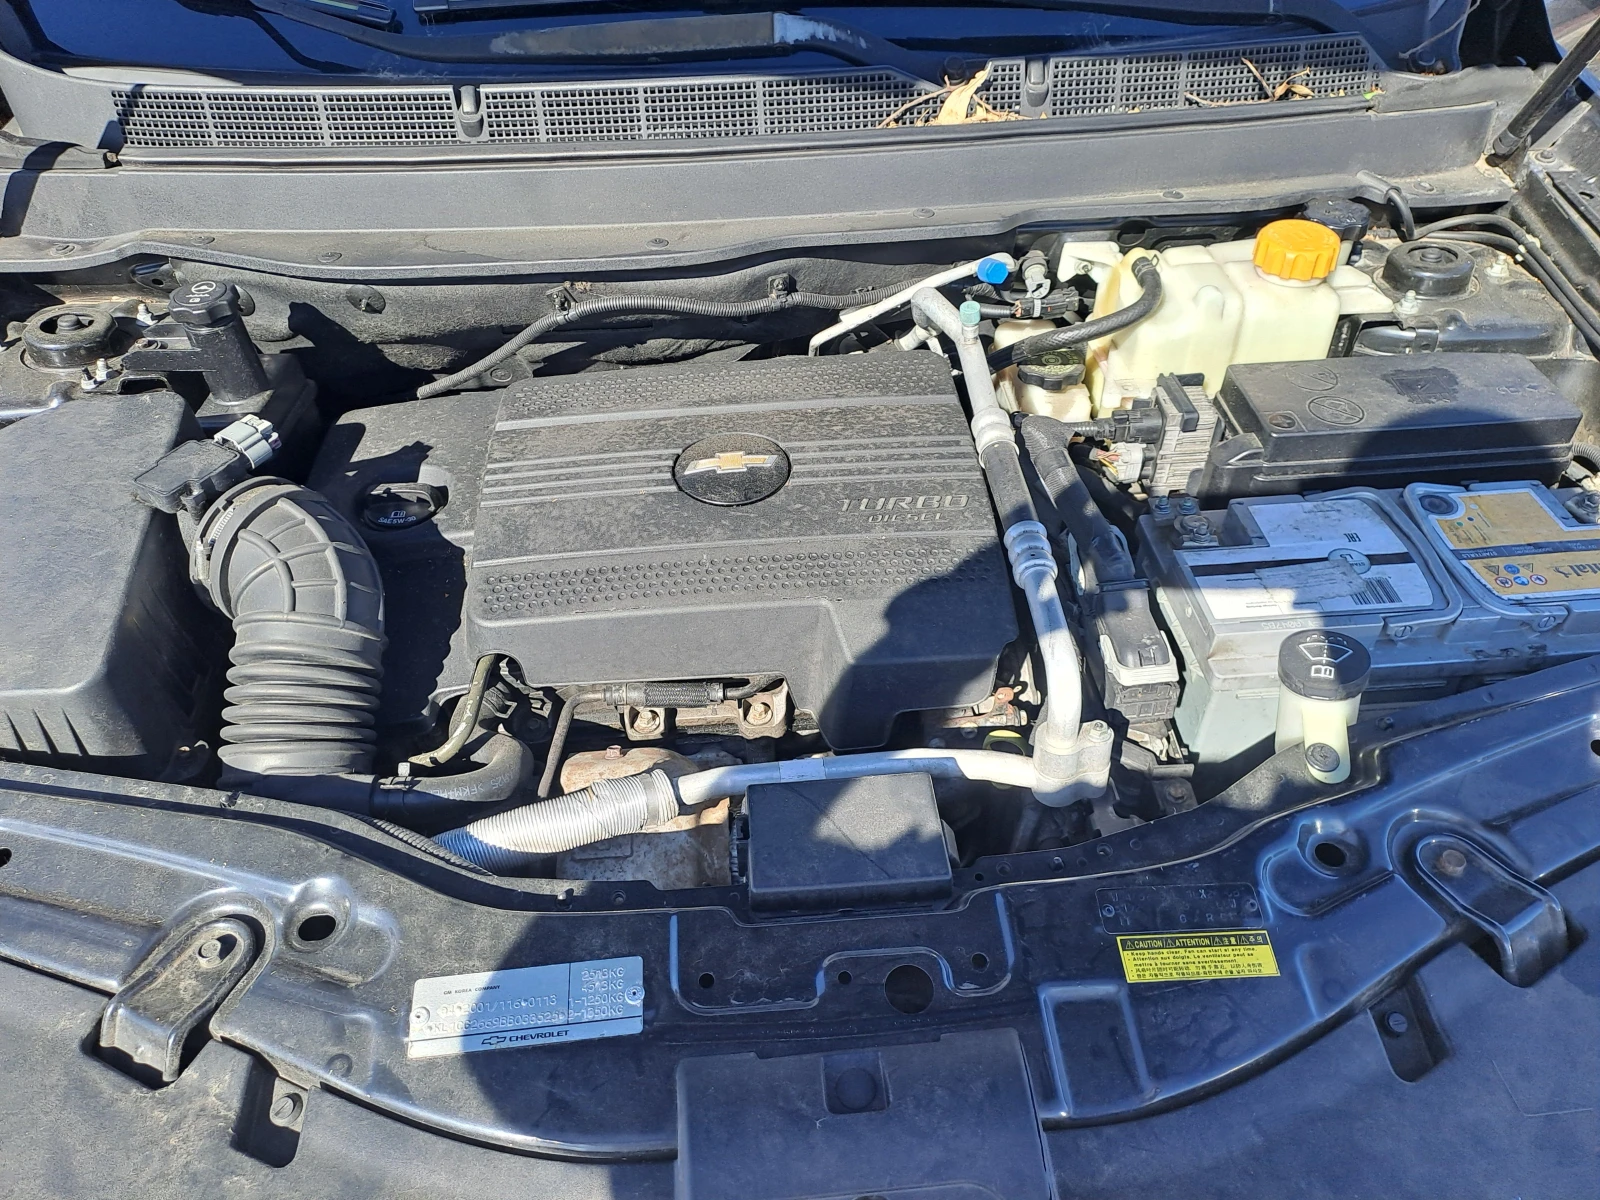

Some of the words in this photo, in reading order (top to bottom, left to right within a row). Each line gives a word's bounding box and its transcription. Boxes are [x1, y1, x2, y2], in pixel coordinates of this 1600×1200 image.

[837, 494, 970, 512] TURBO
[868, 512, 949, 523] DIESEL
[1175, 938, 1210, 947] ATTENTION
[1248, 935, 1264, 944] 주의
[1134, 940, 1163, 949] CAUTION
[474, 984, 501, 992] COMPANY
[509, 1029, 570, 1042] CHEVROLET
